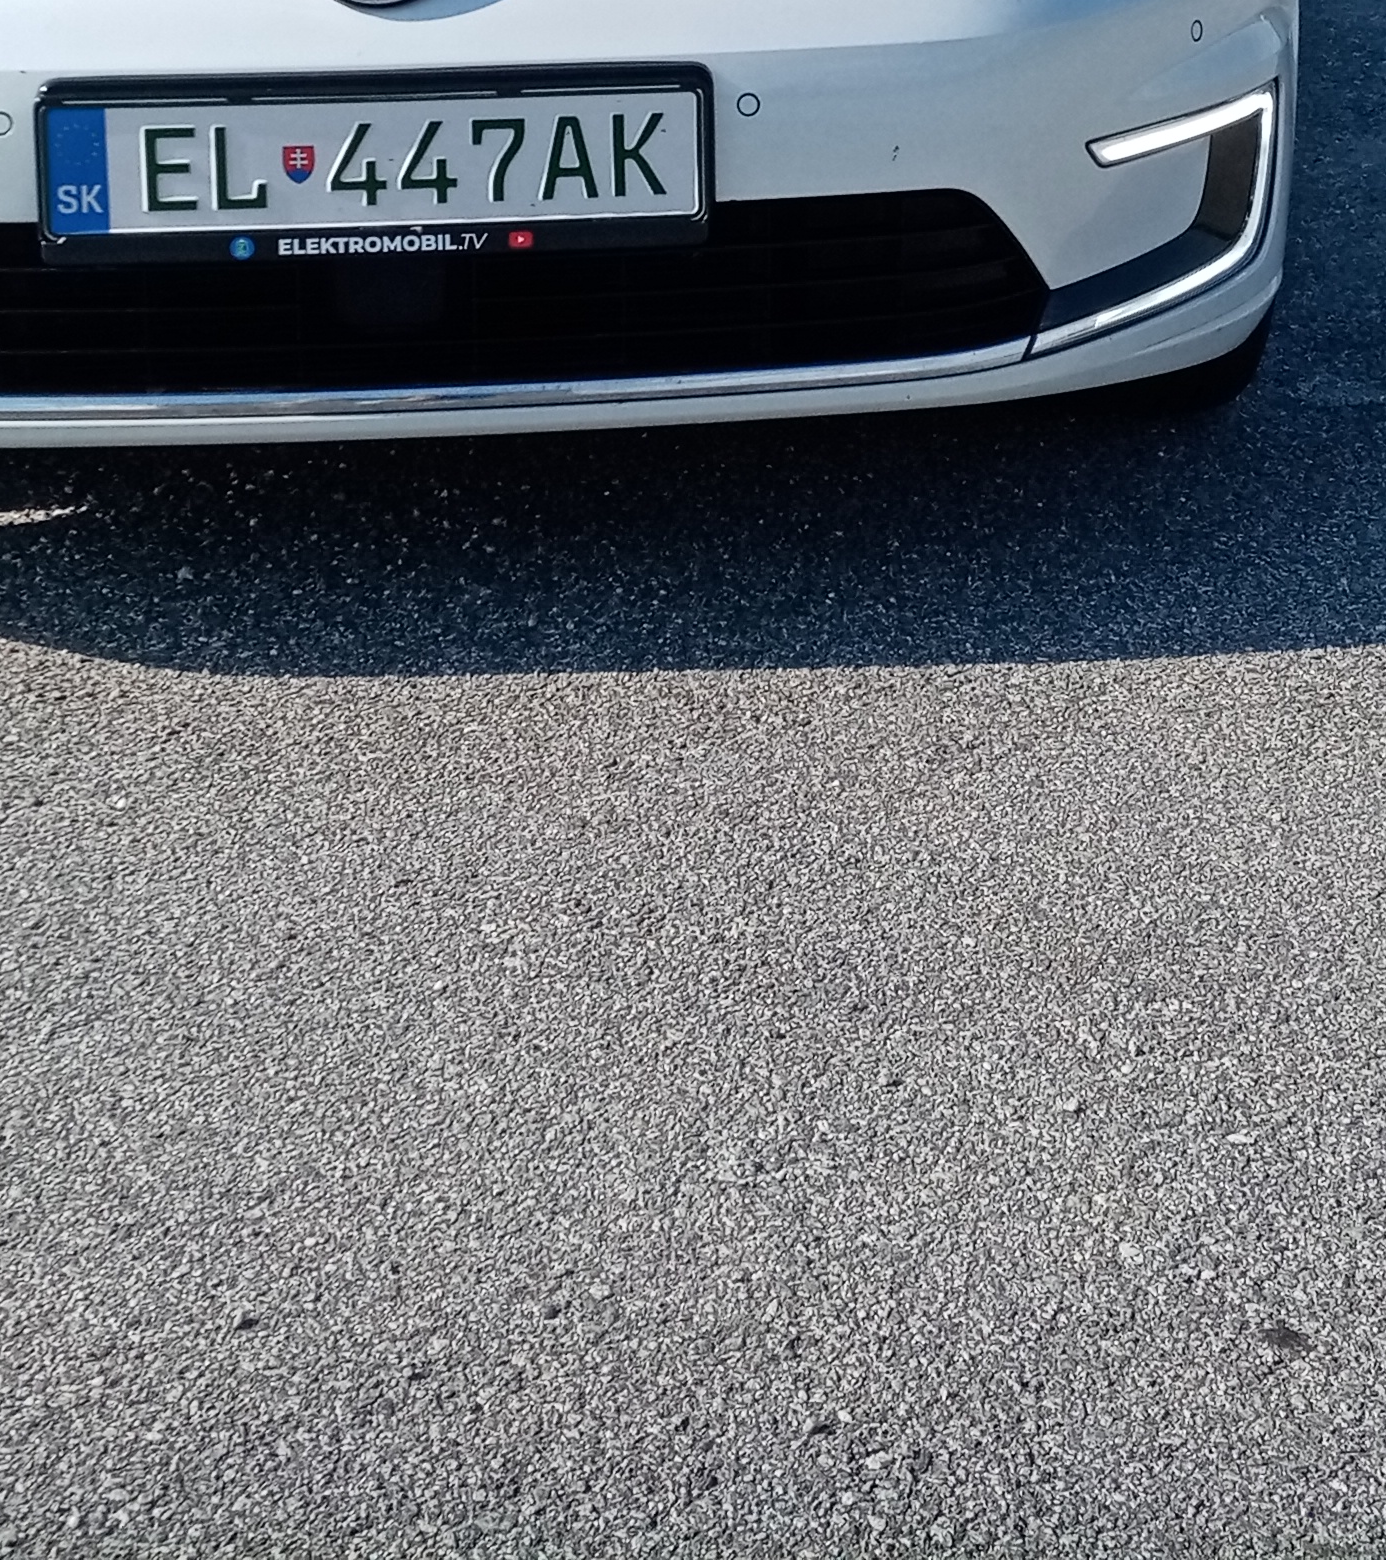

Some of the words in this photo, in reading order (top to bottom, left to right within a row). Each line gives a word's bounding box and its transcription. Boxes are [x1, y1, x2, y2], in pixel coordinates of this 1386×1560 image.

[138, 123, 268, 212] EL
[325, 111, 668, 207] 447AK
[56, 184, 105, 215] SK
[277, 232, 489, 256] ELEKTROMOBIL.TV
